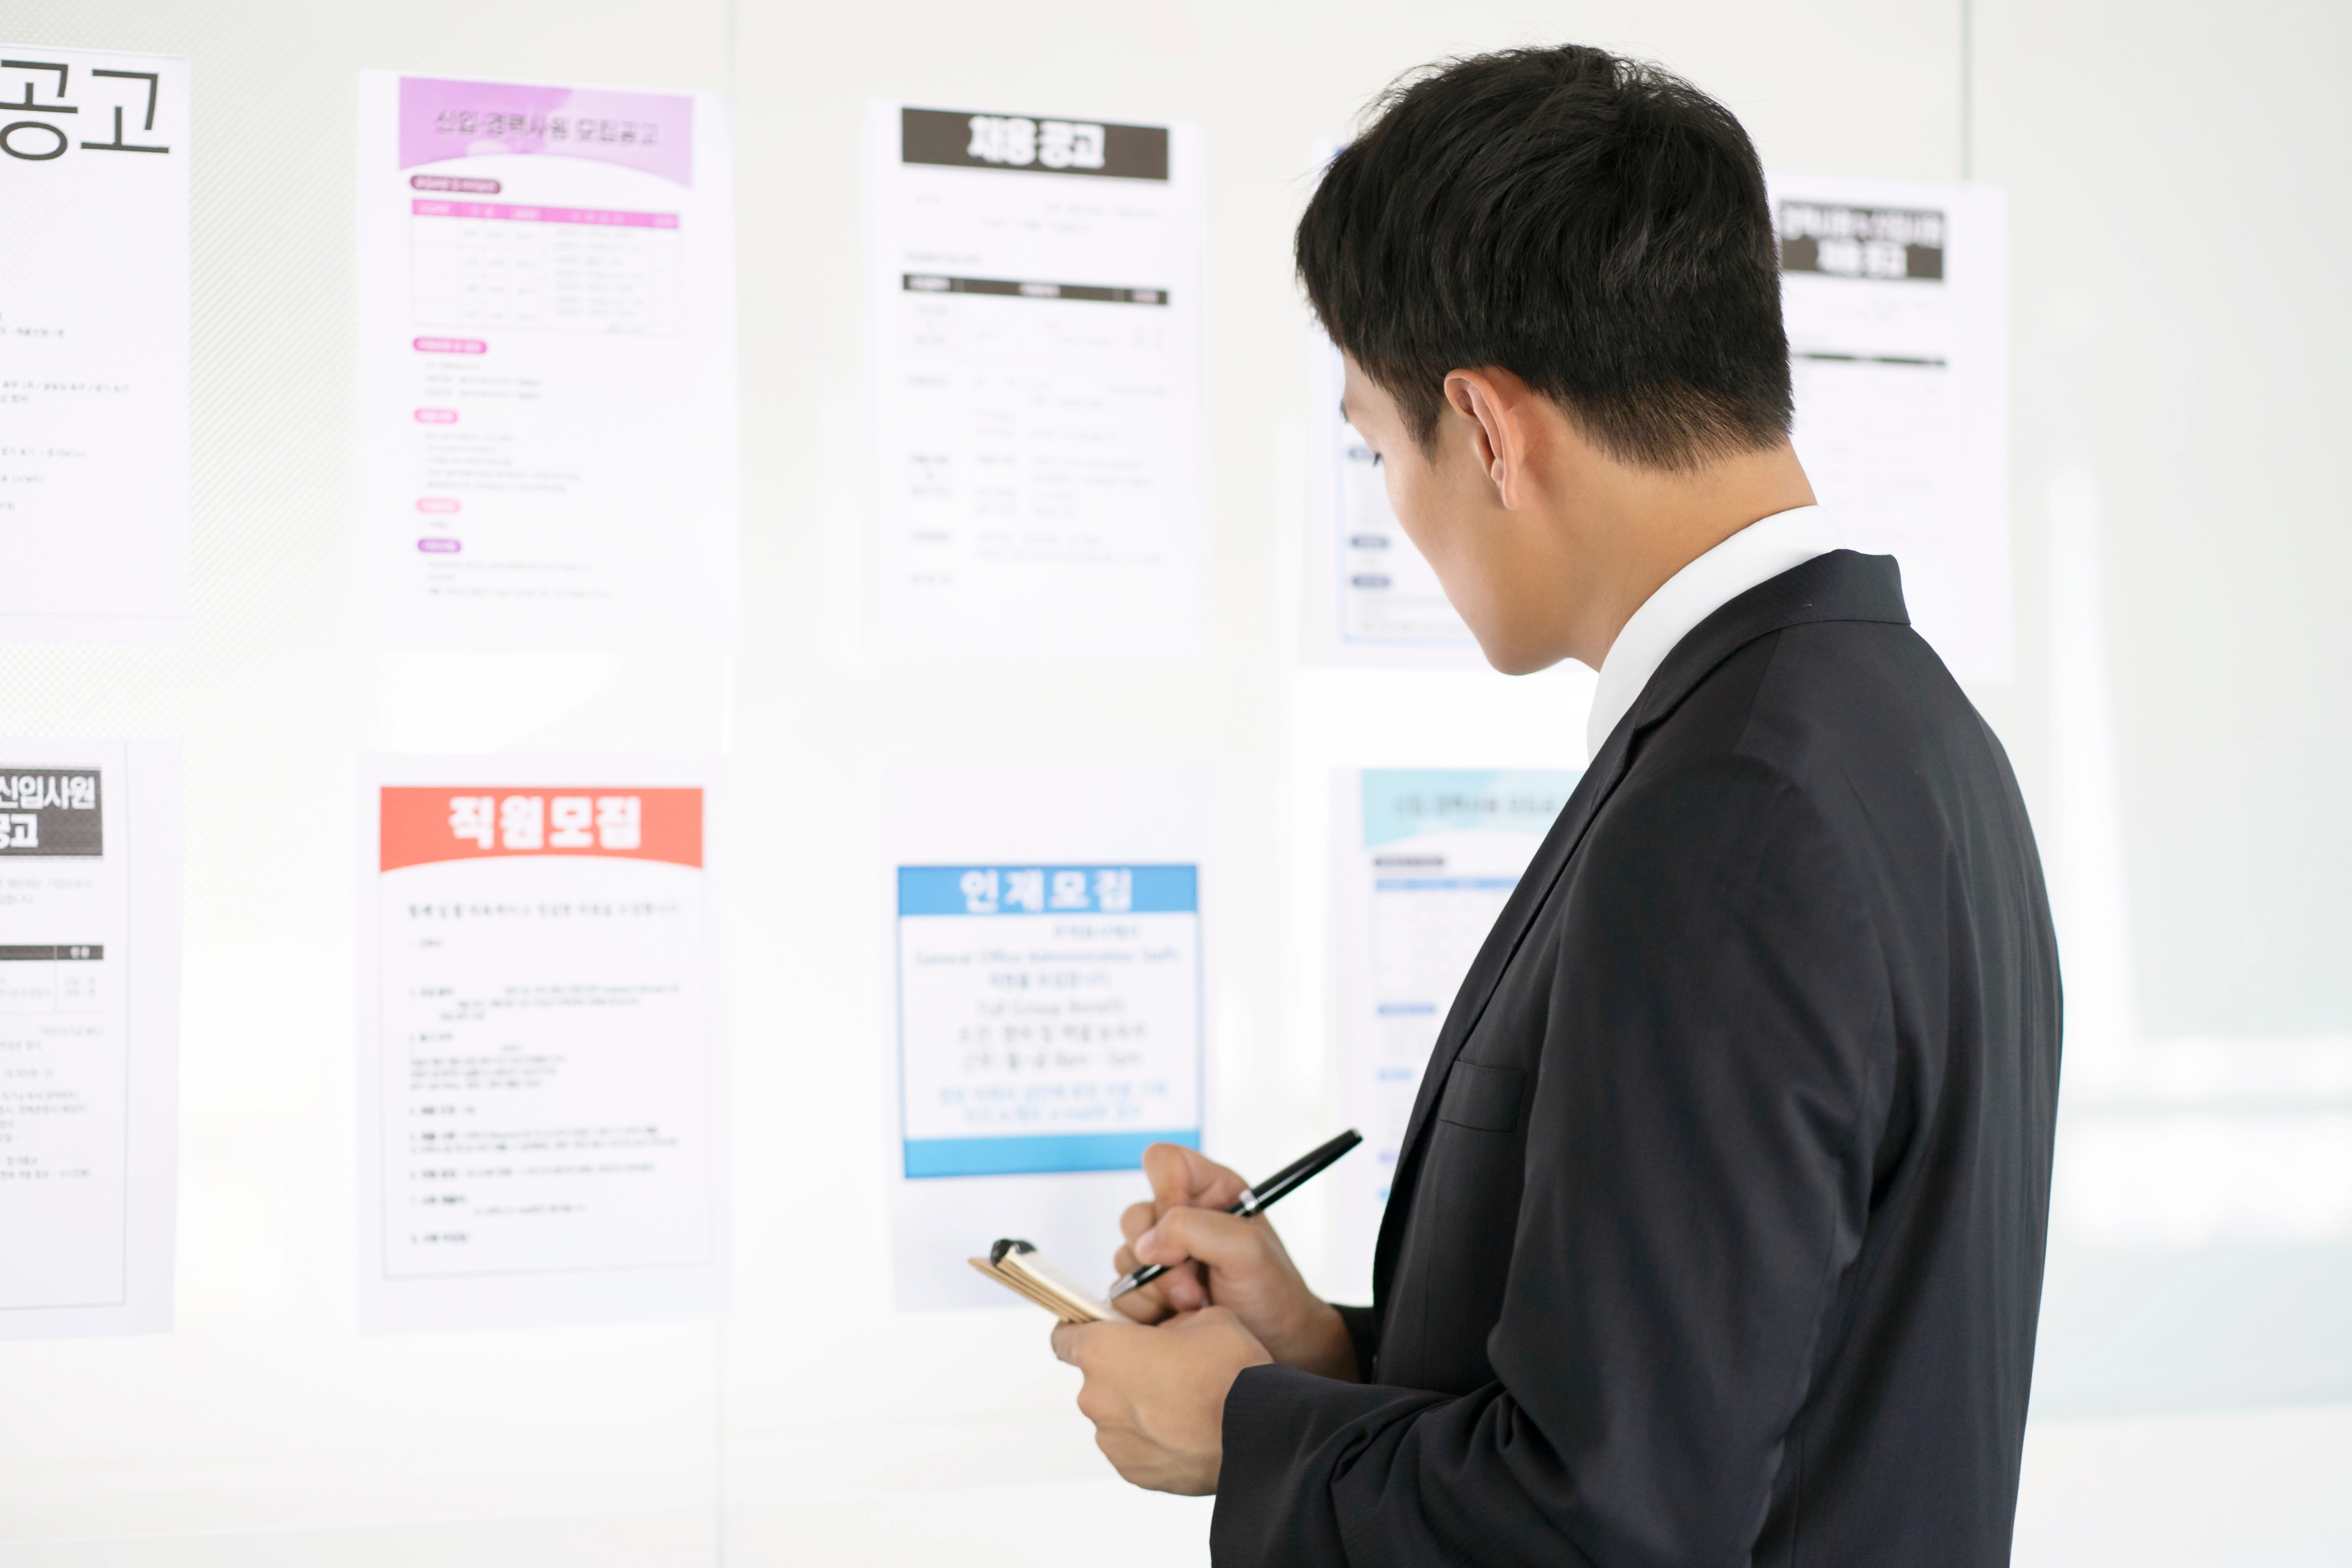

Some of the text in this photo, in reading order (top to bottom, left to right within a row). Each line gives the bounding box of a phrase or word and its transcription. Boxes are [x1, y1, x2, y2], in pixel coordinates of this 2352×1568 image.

[0, 59, 170, 160] 공고
[1038, 121, 1106, 169] 공고
[960, 869, 1133, 913] 인재모집
